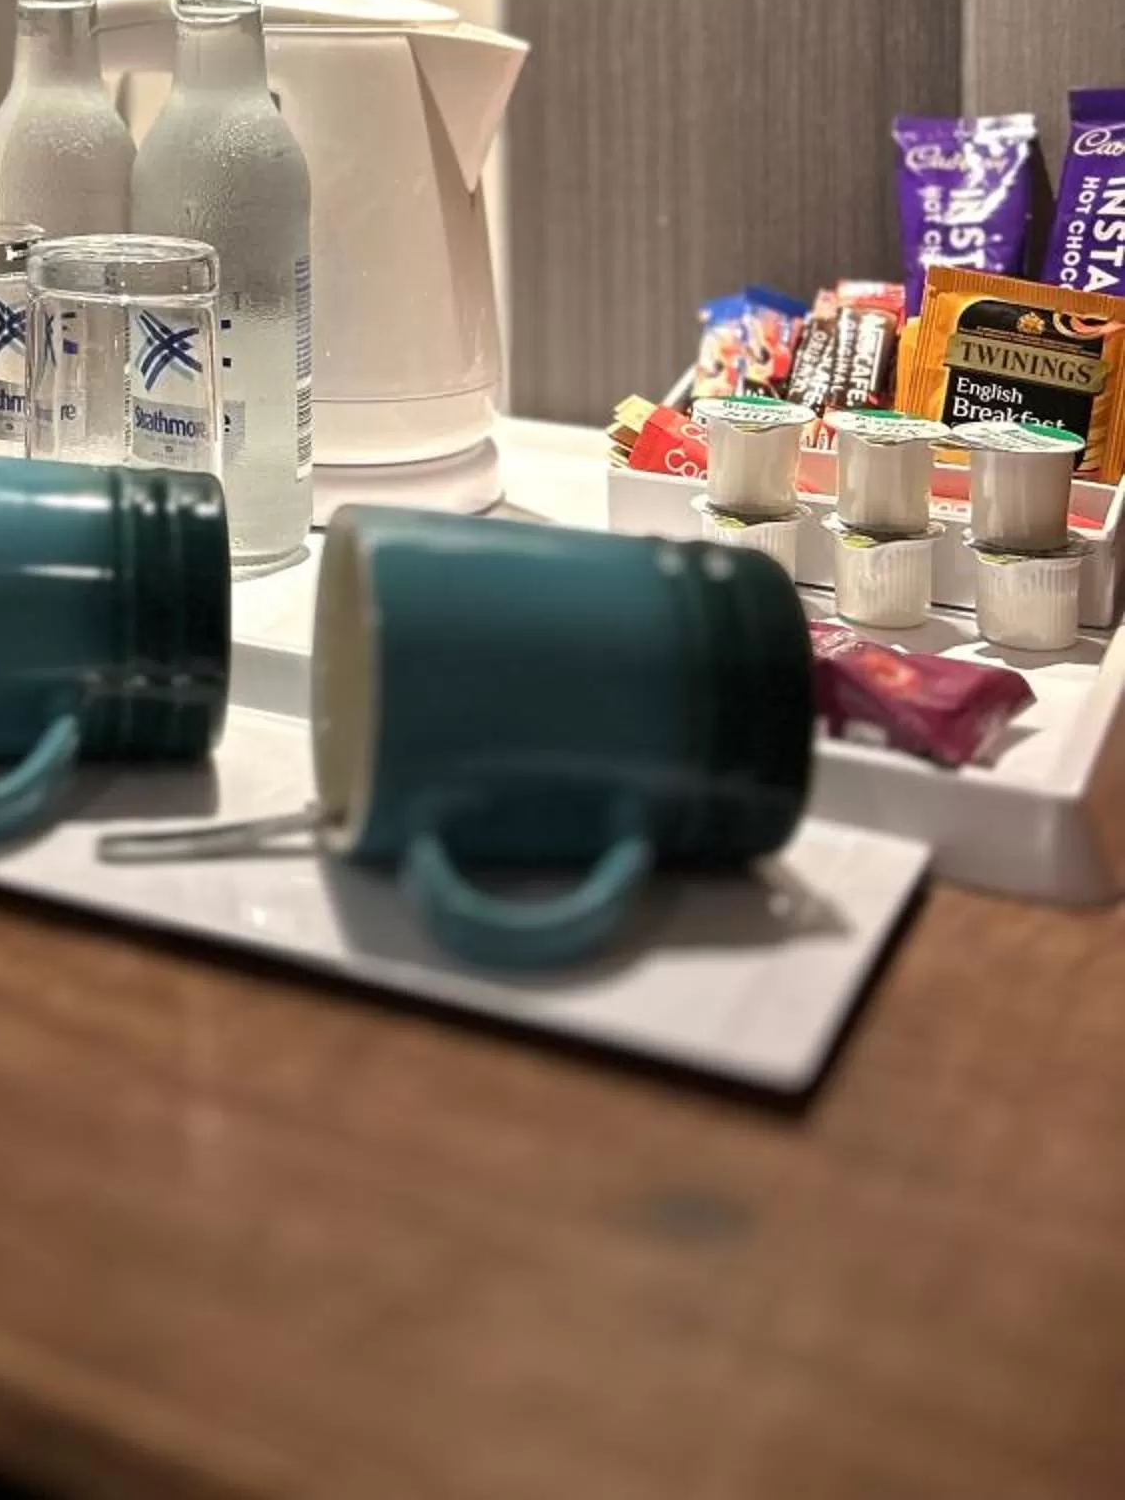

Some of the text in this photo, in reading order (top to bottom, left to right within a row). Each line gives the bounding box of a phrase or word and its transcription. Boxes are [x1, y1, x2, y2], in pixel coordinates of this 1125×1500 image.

[1058, 176, 1101, 289] HOT CHOC
[961, 341, 1094, 385] TWININGS
[956, 377, 1023, 404] English
